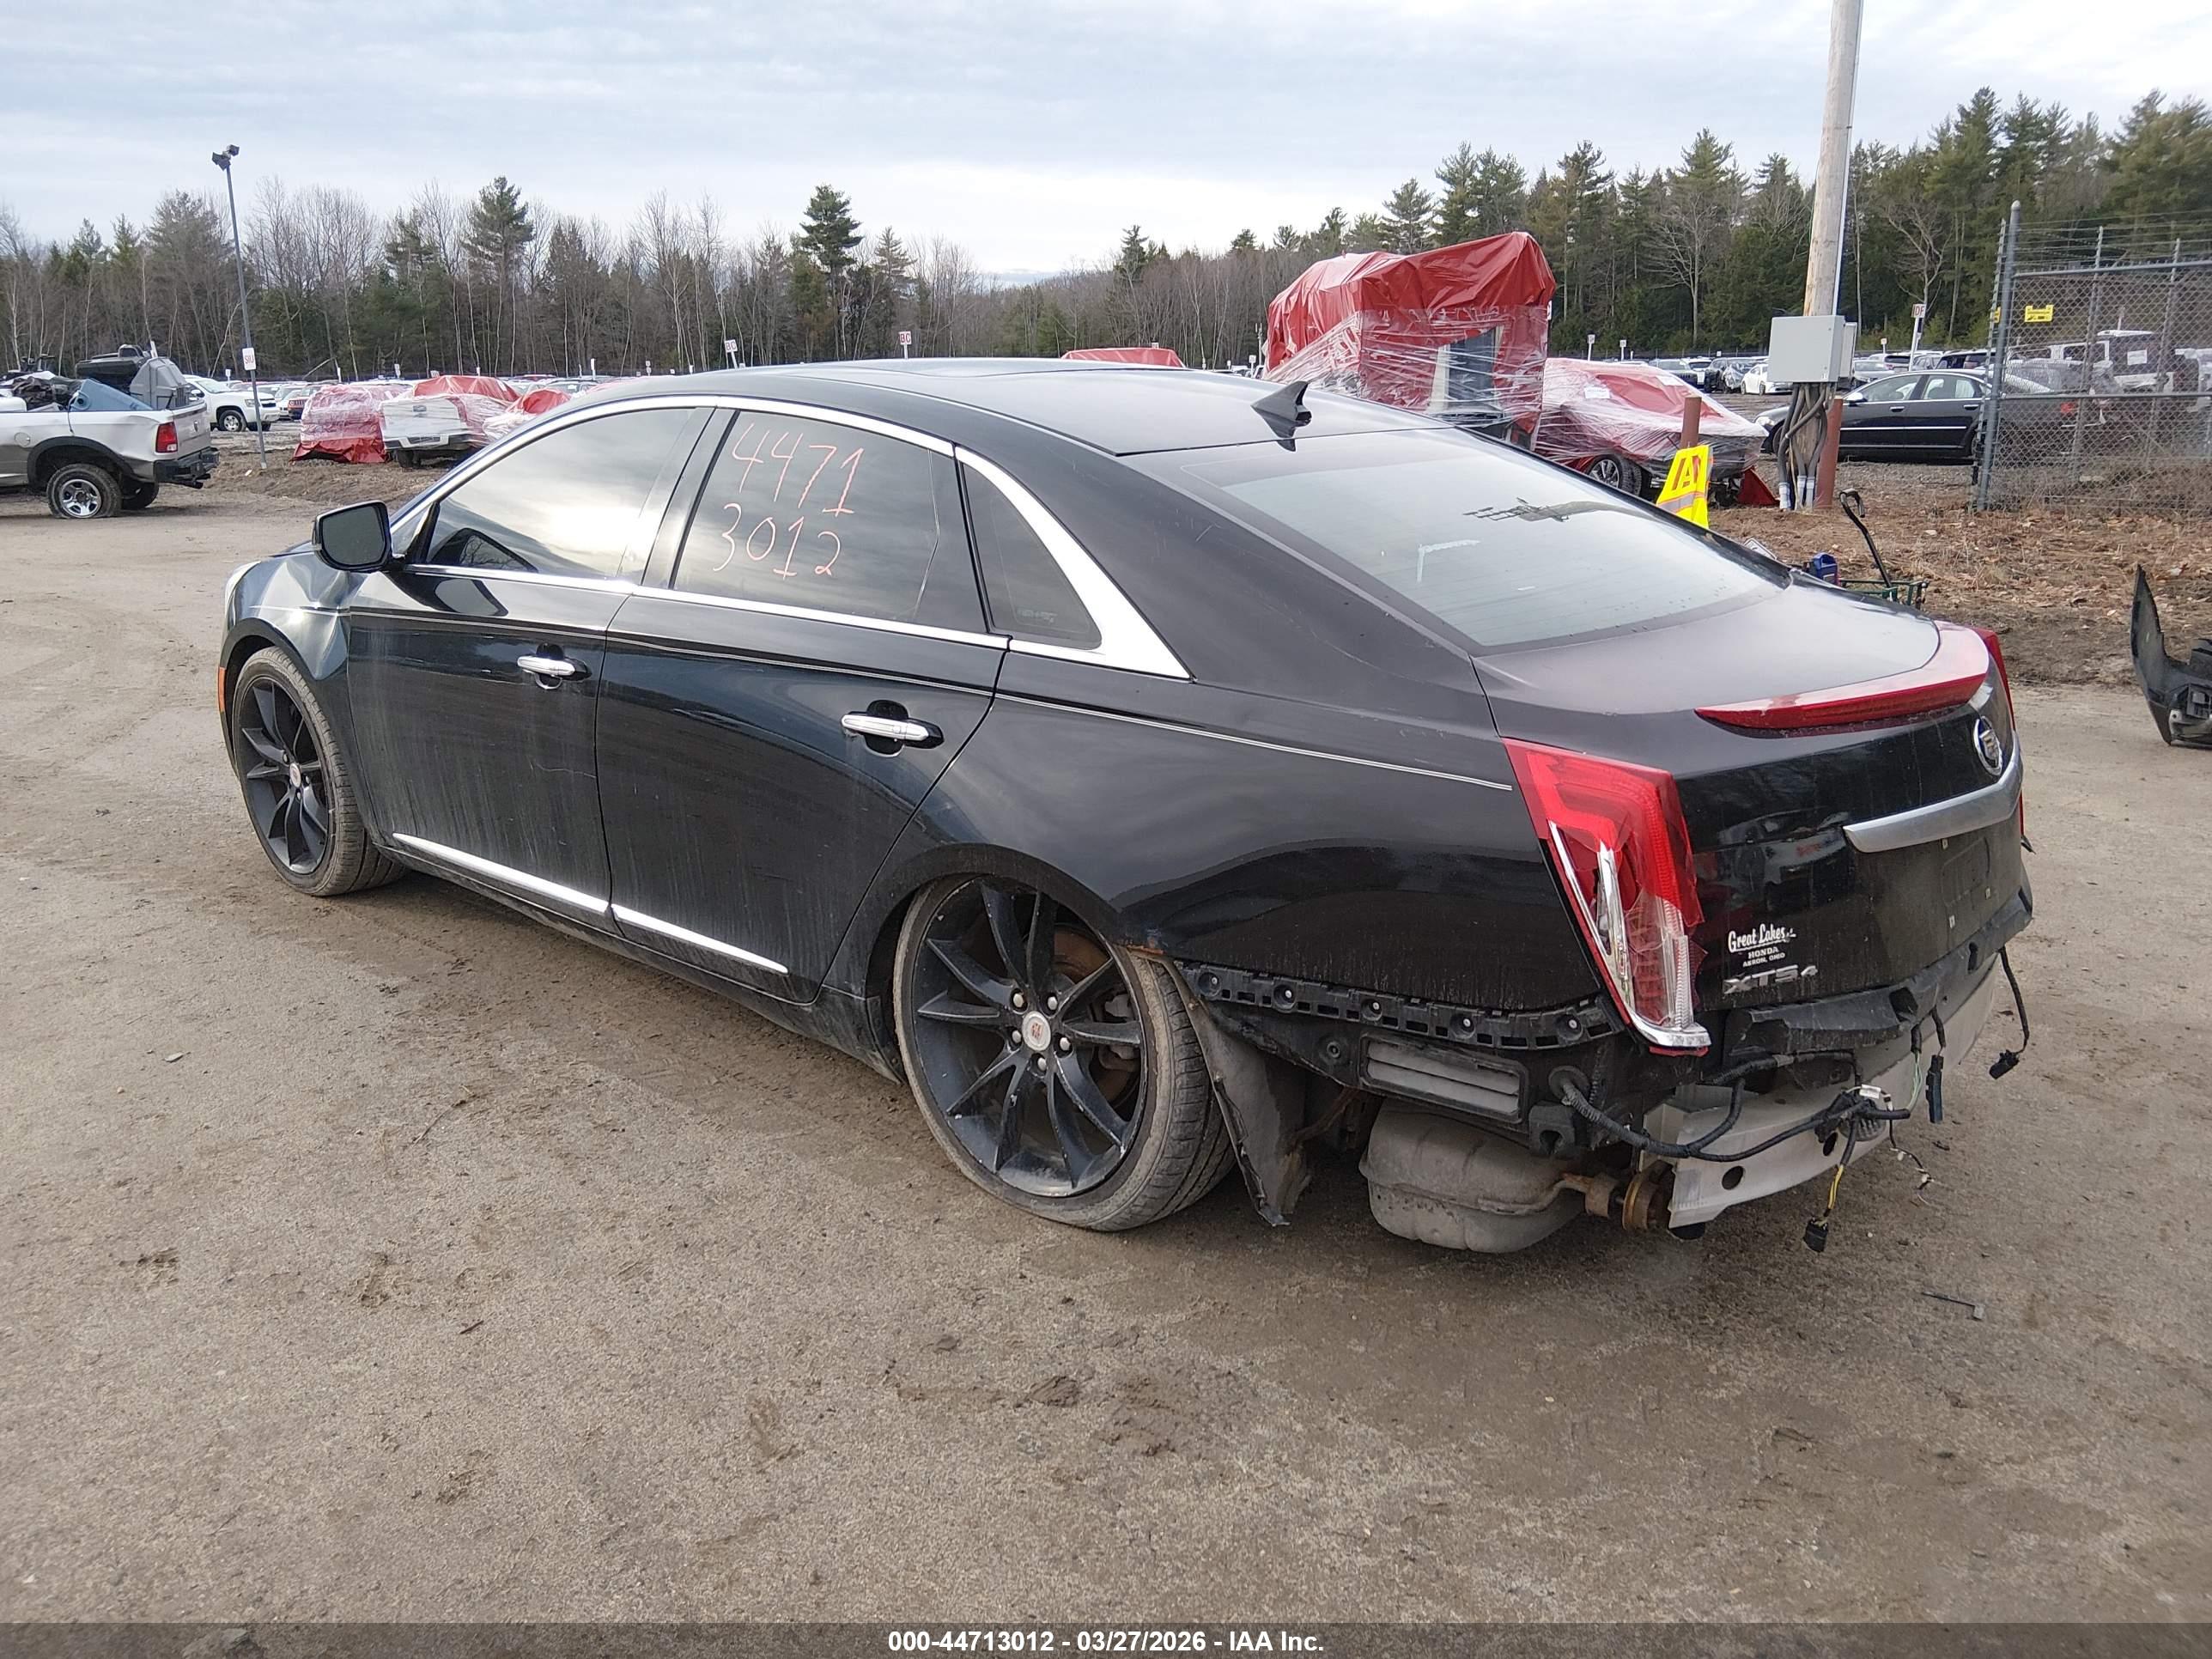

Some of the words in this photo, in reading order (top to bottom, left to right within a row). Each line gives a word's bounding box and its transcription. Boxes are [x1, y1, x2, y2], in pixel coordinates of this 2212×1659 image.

[900, 333, 911, 343] BC
[732, 422, 864, 517] 4471
[713, 502, 841, 580] 3012
[1728, 928, 1758, 953] Great
[1759, 923, 1785, 944] Lakes
[1747, 946, 1779, 959] HONDA
[1768, 952, 1786, 961] OHIO
